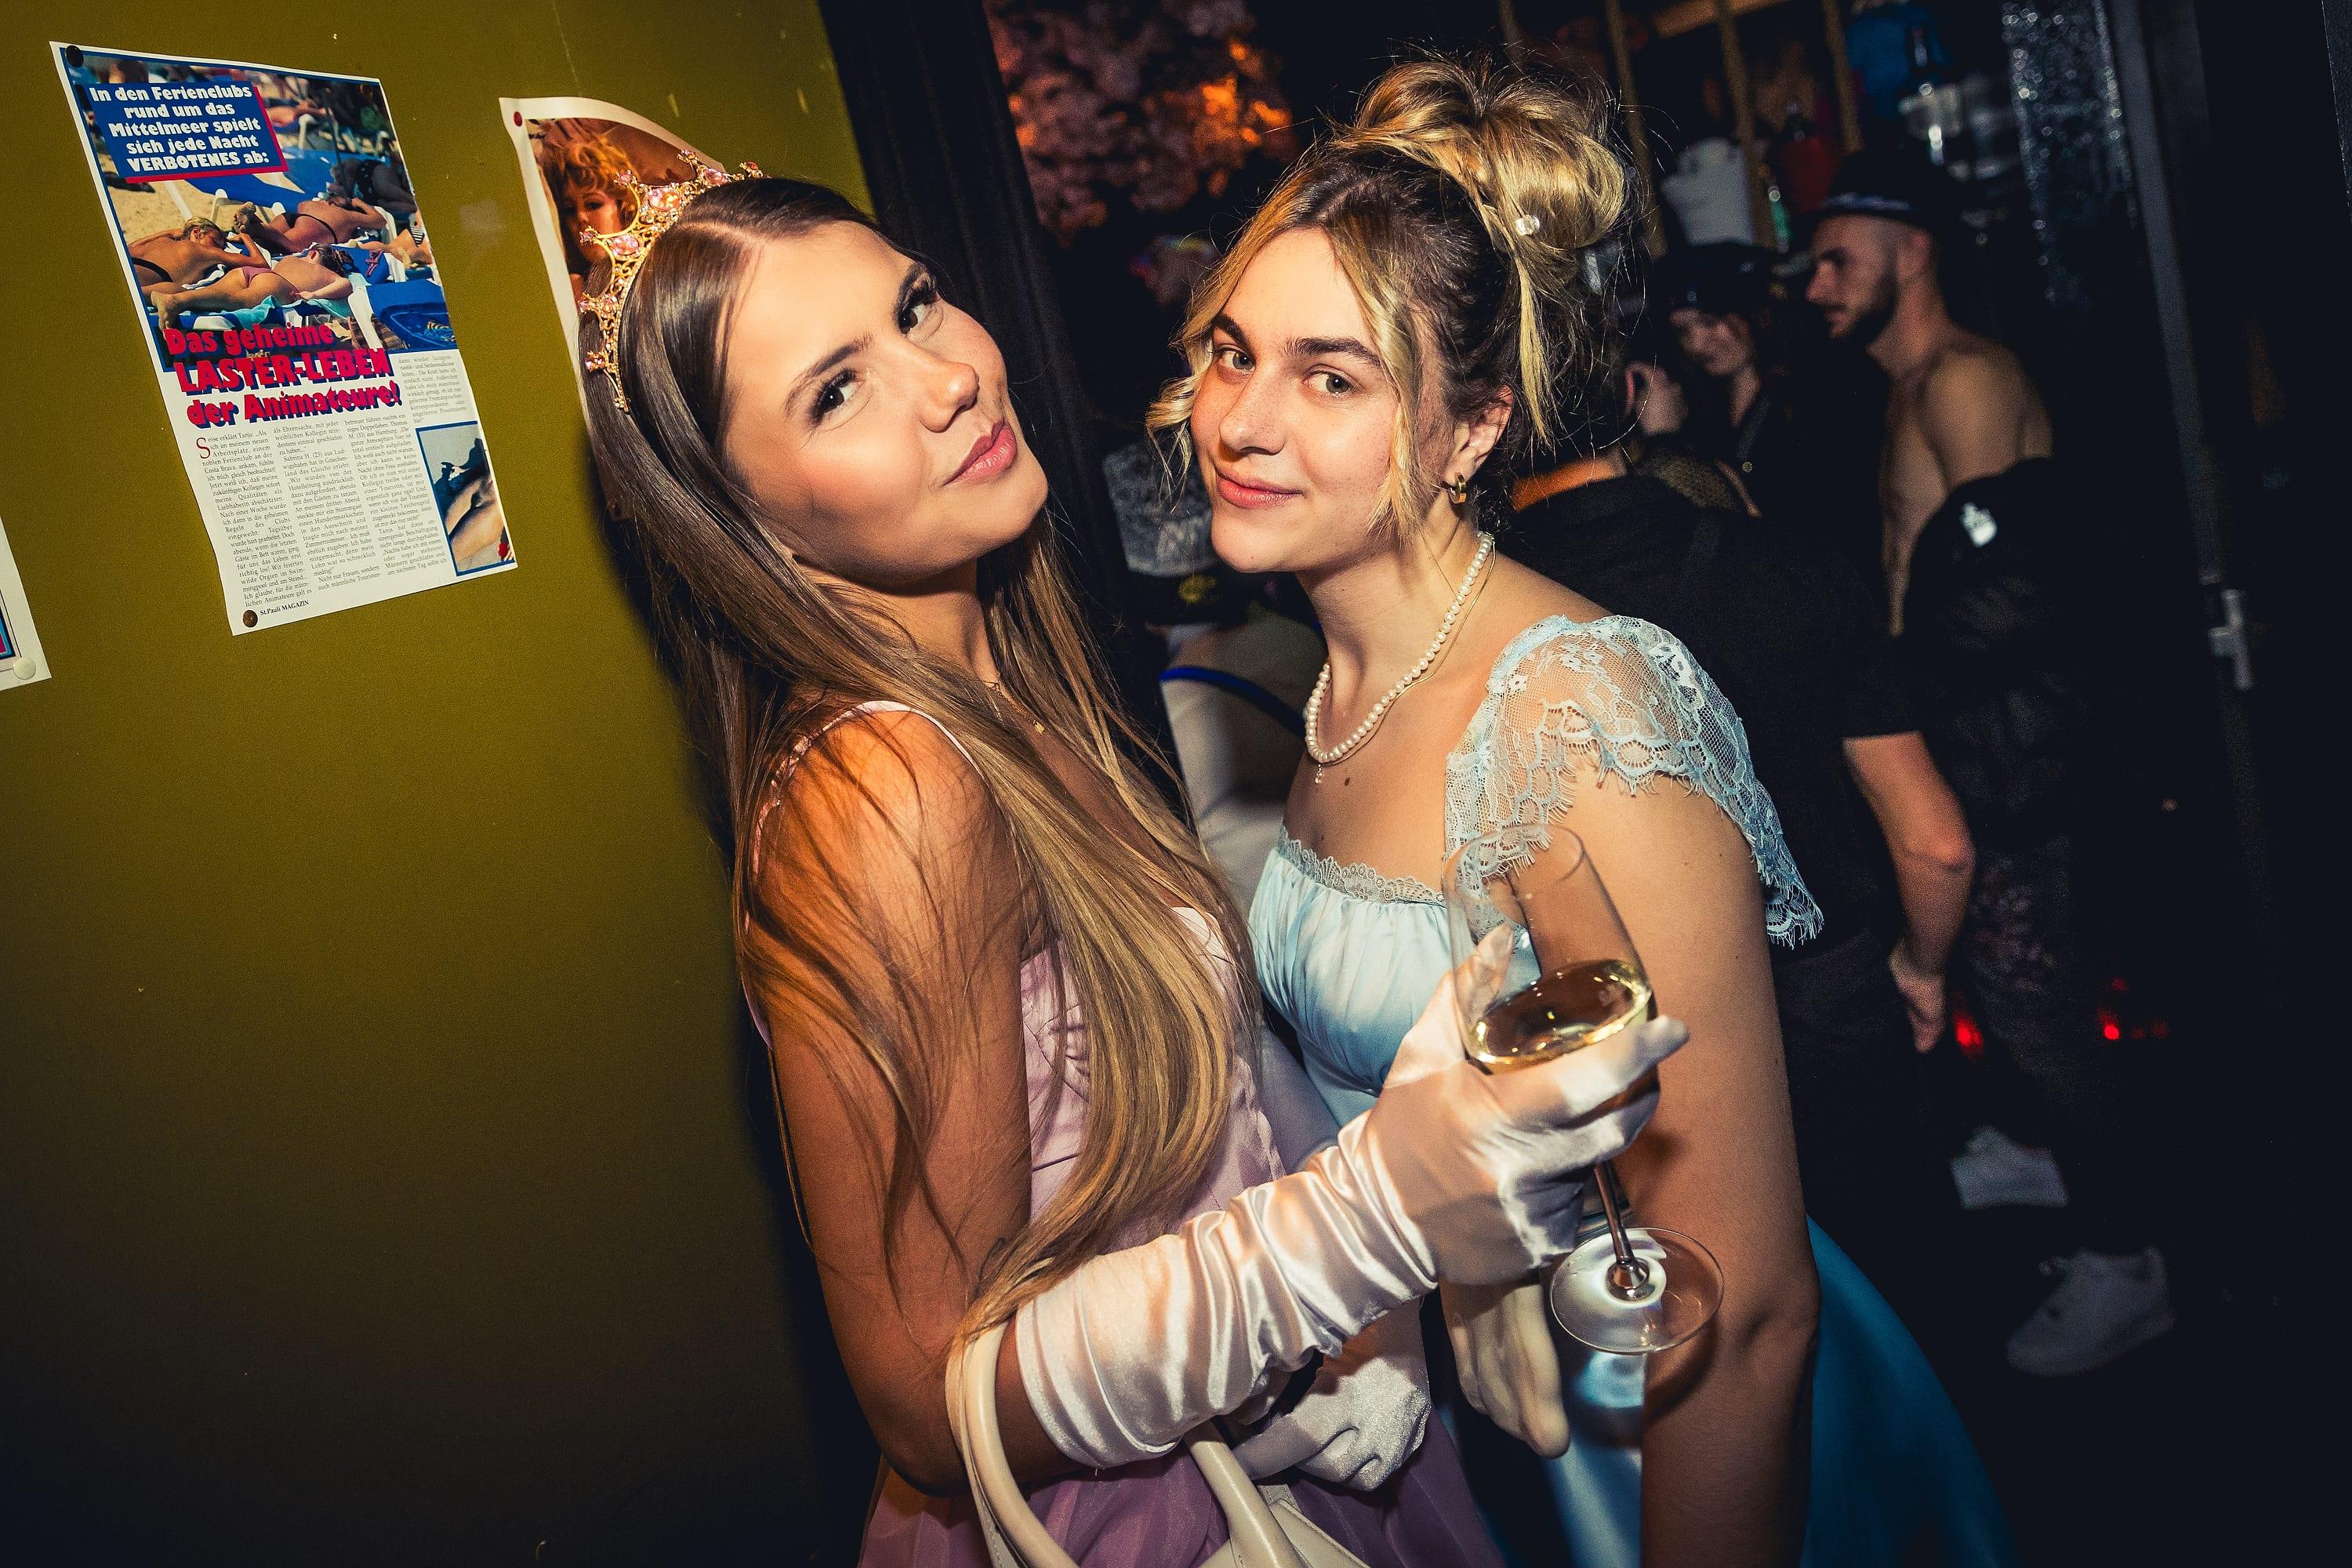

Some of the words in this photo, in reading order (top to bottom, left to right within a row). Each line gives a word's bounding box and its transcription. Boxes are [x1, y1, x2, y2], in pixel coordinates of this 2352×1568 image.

[89, 86, 112, 102] In
[114, 85, 150, 101] den
[151, 84, 252, 101] Ferienclubs
[124, 104, 169, 119] rund
[173, 105, 203, 118] um
[205, 102, 235, 116] das
[108, 120, 209, 137] Mittelmeer
[214, 118, 261, 134] spielt
[126, 140, 165, 155] sich
[168, 136, 206, 155] jede
[208, 134, 260, 150] Nacht
[126, 152, 241, 172] VERBOTENES
[243, 151, 270, 165] ab:
[163, 328, 219, 355] Das
[223, 321, 335, 356] geheime
[173, 347, 394, 394] LASTER-LEBEN
[187, 398, 239, 429] der
[244, 379, 403, 423] Animateure!
